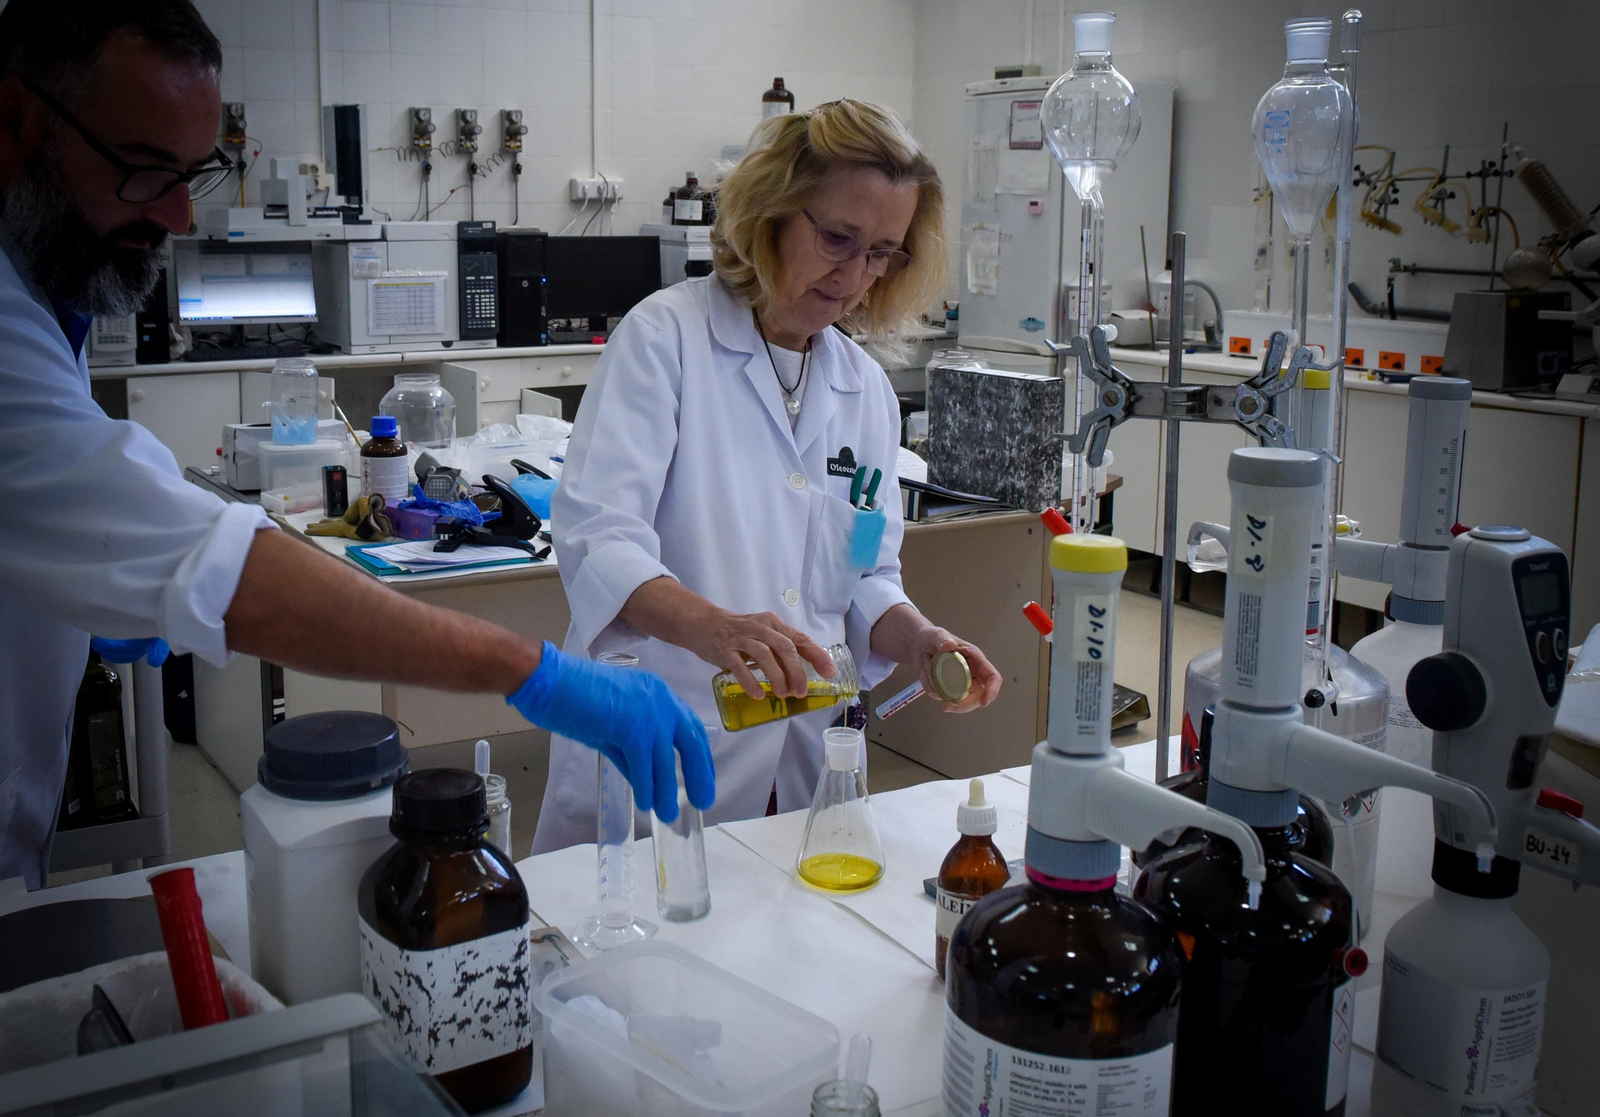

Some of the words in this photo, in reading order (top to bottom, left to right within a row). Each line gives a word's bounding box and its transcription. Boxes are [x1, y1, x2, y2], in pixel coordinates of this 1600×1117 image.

[1526, 834, 1570, 865] BU-14
[1471, 997, 1488, 1046] AppliChem
[1464, 1060, 1479, 1096] PanReac
